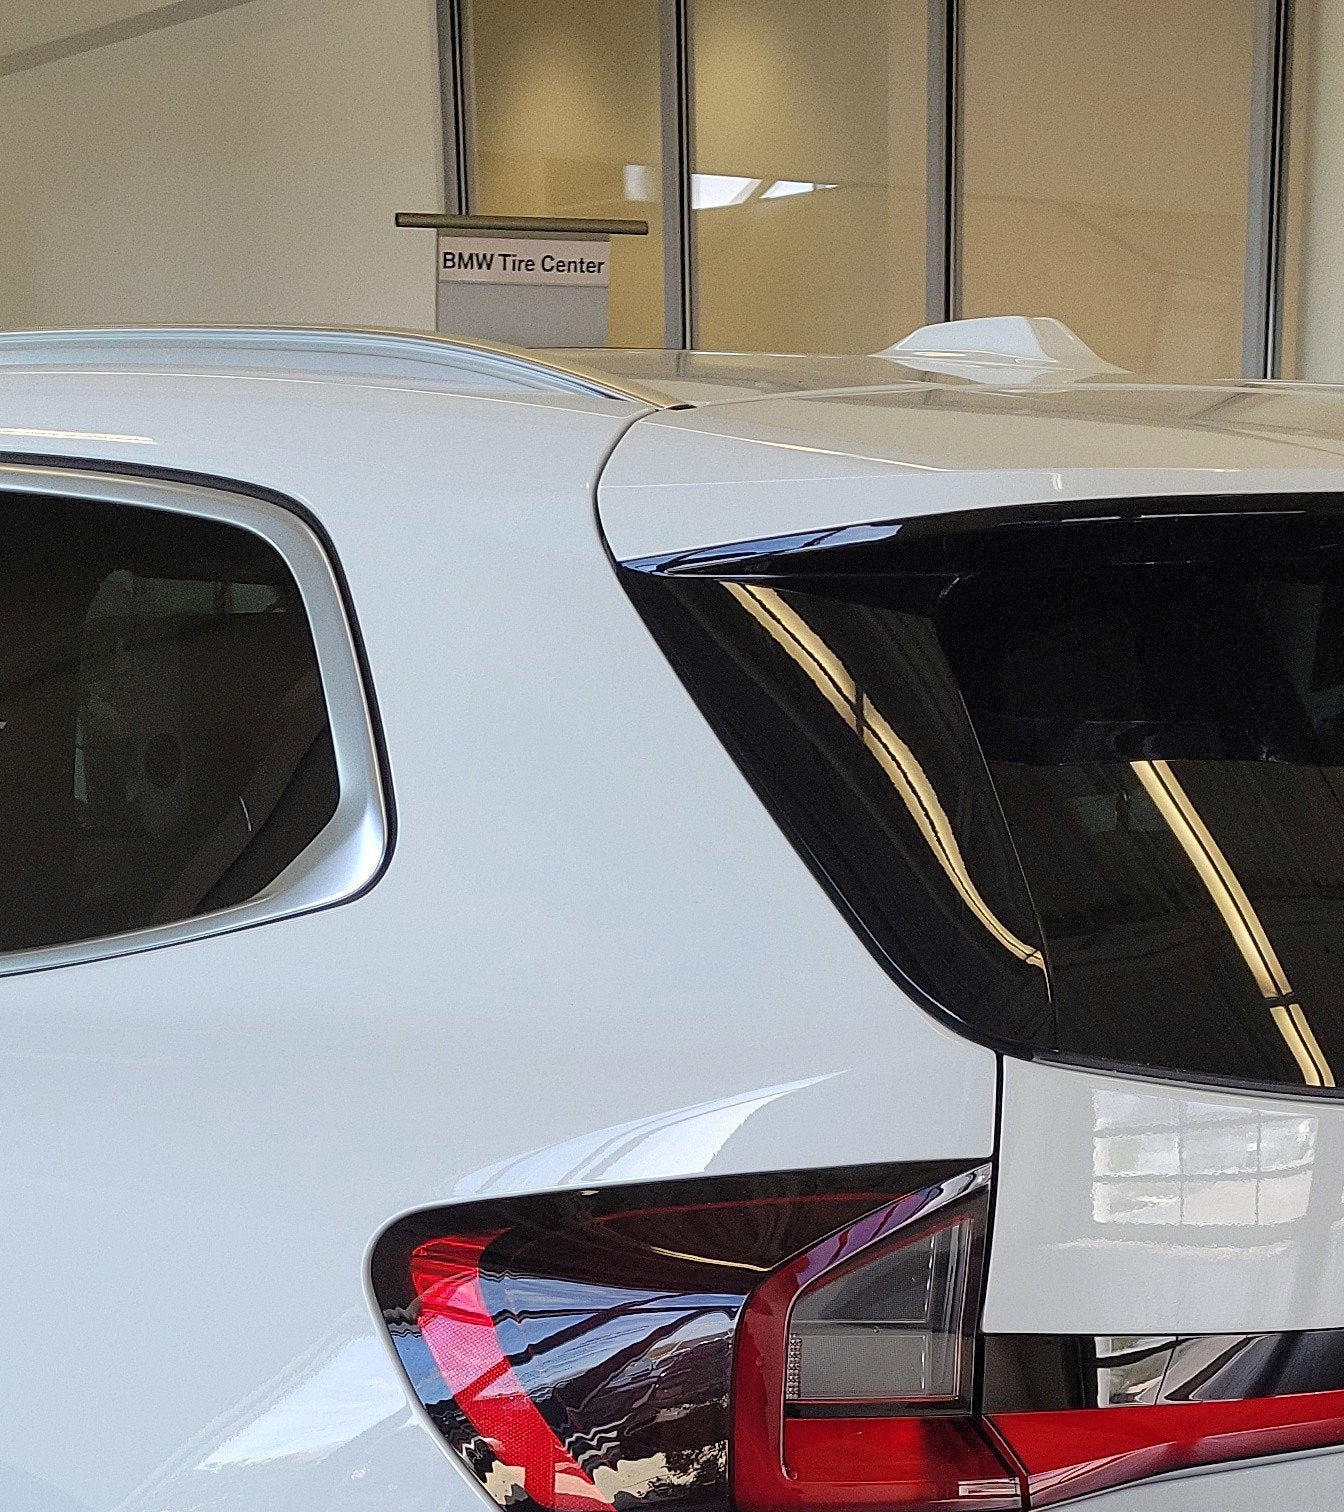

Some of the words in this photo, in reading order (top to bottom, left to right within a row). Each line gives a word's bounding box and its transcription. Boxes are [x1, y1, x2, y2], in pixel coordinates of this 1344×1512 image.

[442, 251, 495, 271] BMW
[497, 253, 535, 272] Tire
[541, 254, 605, 274] Center
